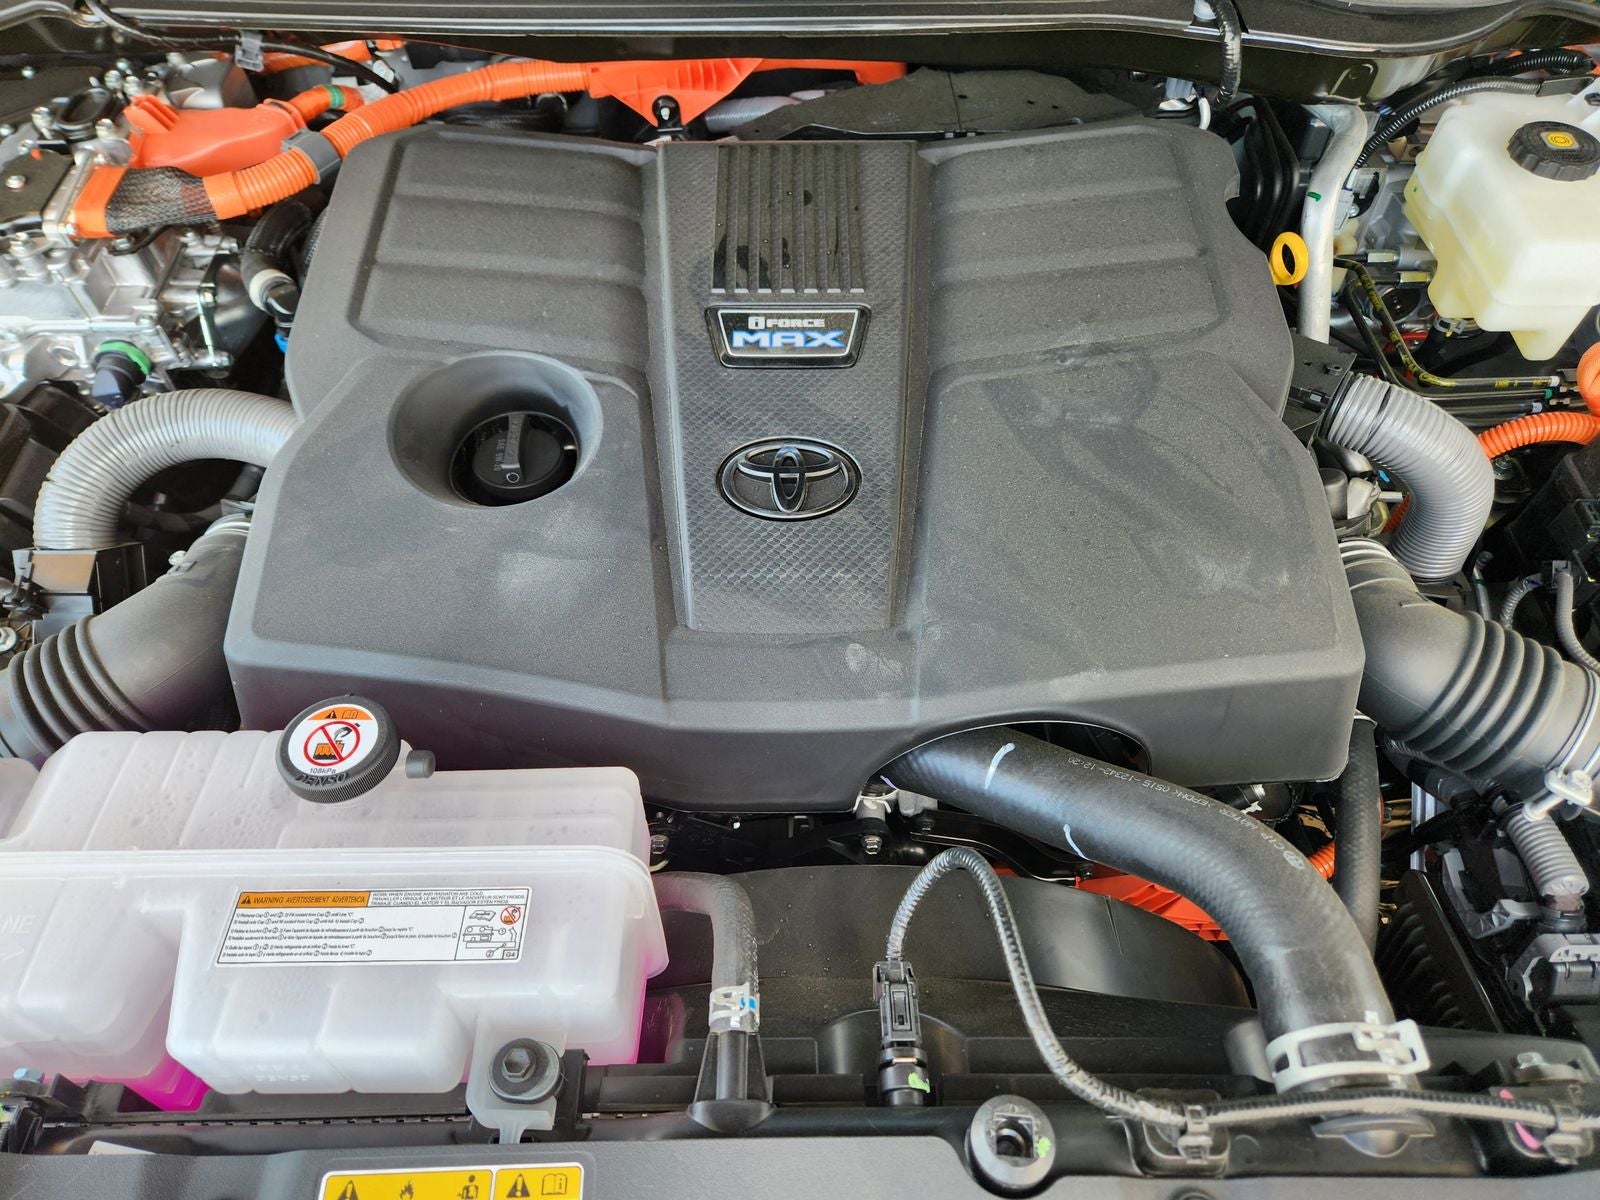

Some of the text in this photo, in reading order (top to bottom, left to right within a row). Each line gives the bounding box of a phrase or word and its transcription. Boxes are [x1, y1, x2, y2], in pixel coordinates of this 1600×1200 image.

[732, 330, 845, 348] MAX
[309, 767, 337, 775] 108kPa
[295, 772, 349, 787] DENSO
[1219, 808, 1258, 830] WATER
[253, 895, 365, 904] WARNING AVERTISSEMENT ADVERTENCIA
